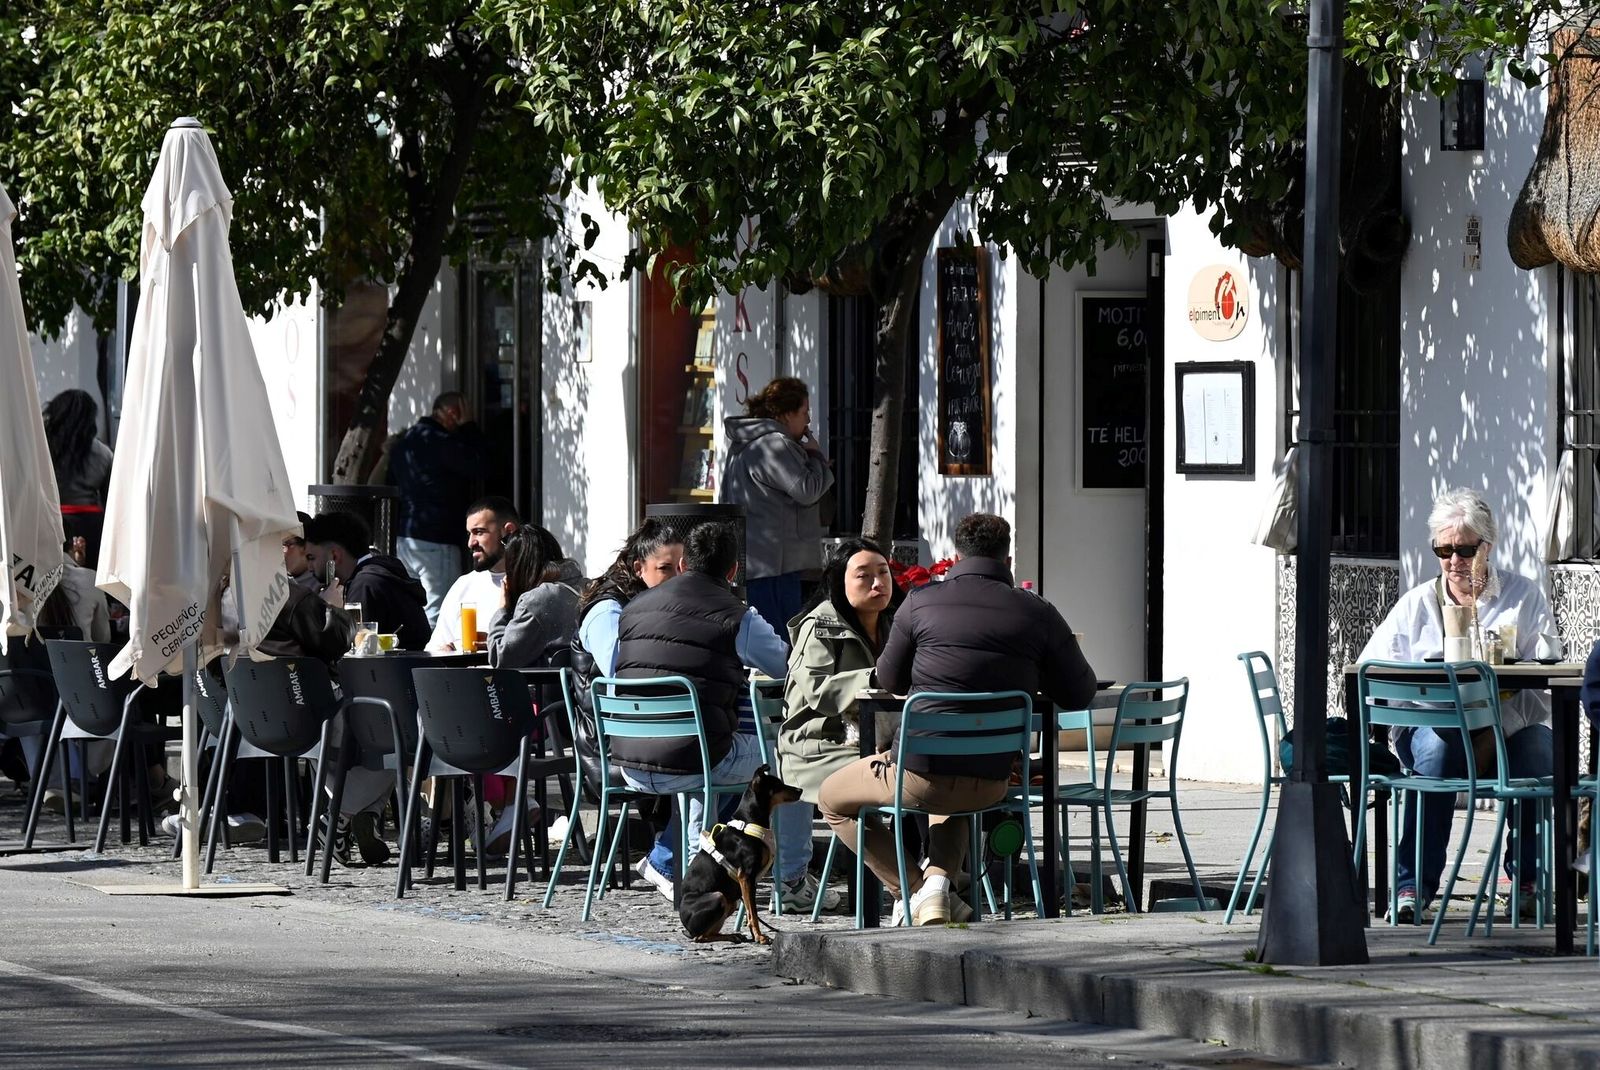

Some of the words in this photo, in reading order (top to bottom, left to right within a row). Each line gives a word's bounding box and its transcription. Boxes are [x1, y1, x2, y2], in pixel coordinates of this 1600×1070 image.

[1098, 307, 1146, 325] MOJI
[284, 314, 300, 420] OS
[91, 655, 107, 689] AMBAR
[289, 670, 305, 706] AMBAR
[486, 683, 504, 720] AMBAR
